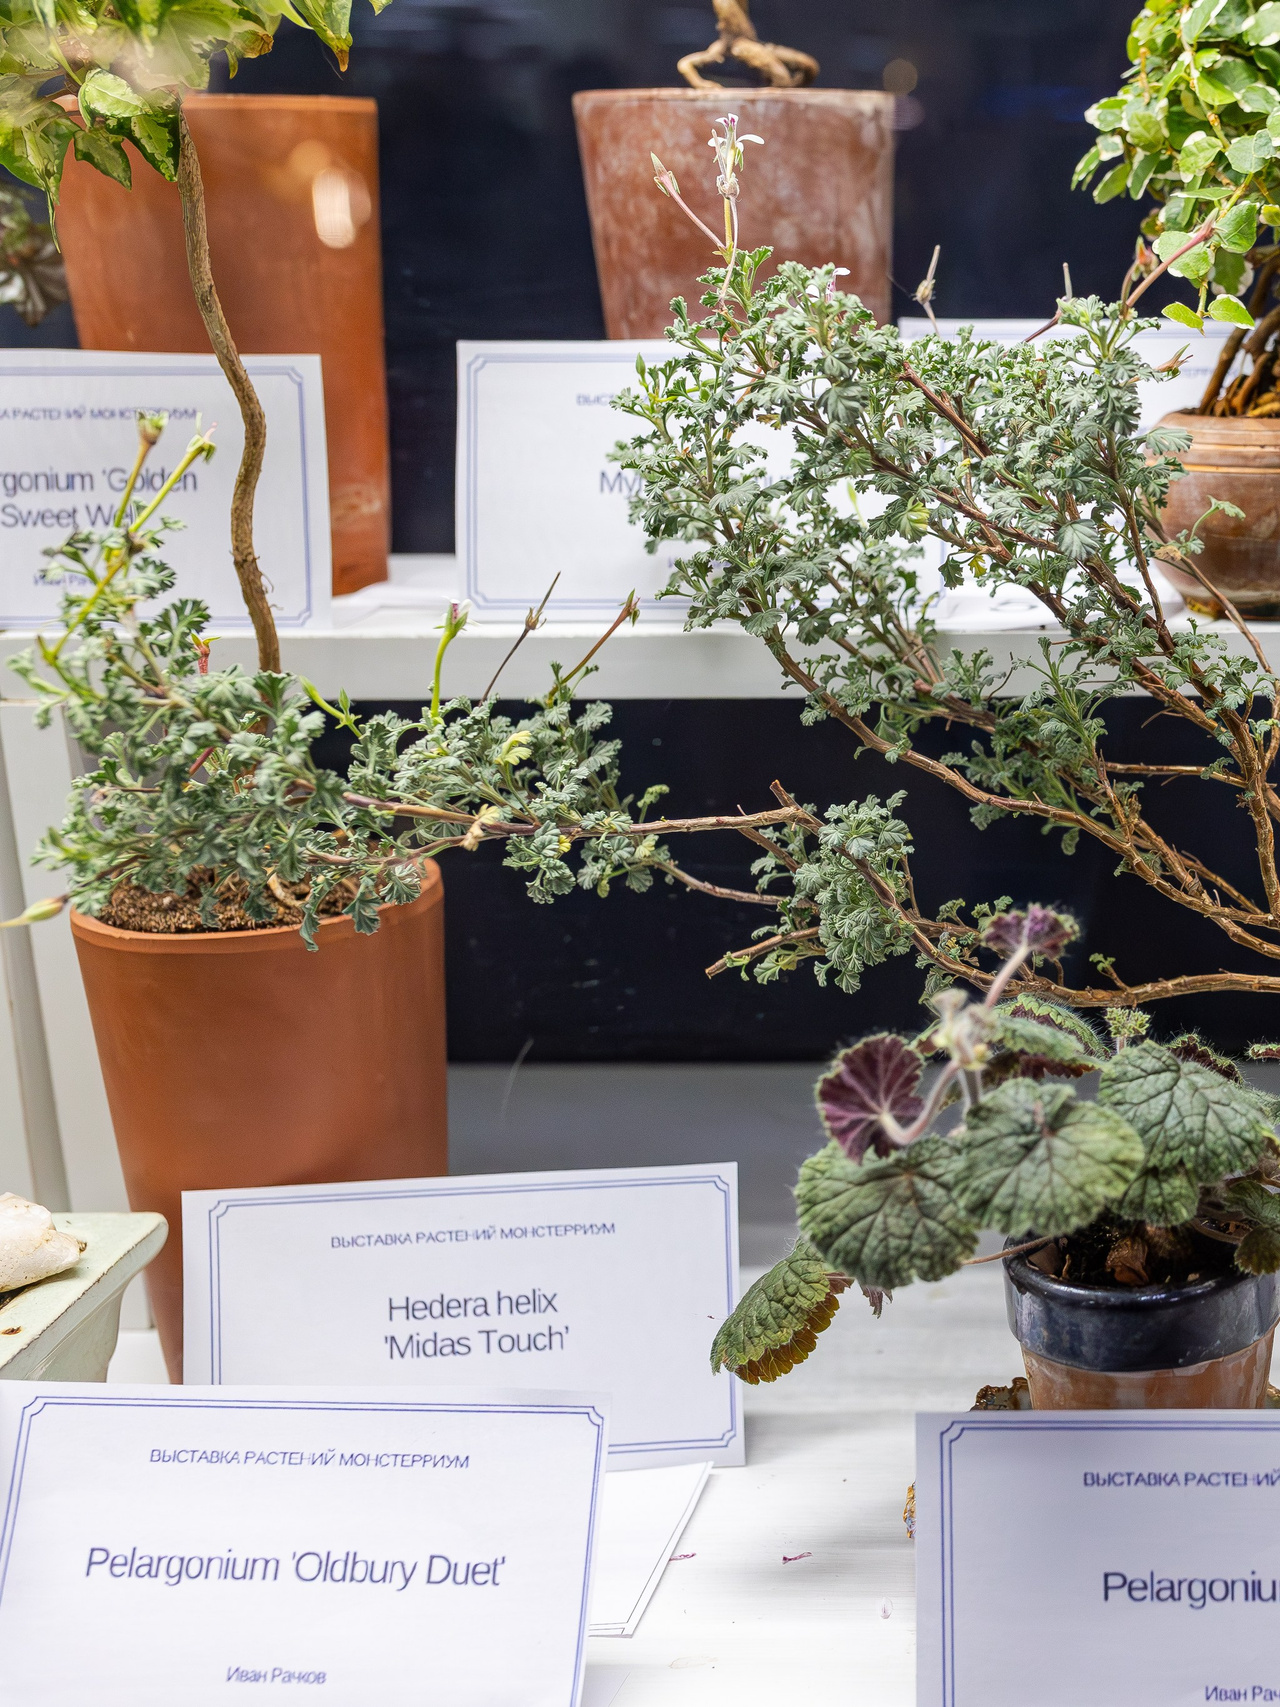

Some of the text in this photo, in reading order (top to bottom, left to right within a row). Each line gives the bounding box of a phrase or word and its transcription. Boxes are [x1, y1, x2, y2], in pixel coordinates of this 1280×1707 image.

[0, 465, 94, 498] gonium
[1, 503, 77, 528] Sweet
[331, 1222, 616, 1249] ВЫСТАВКА РАСТЕНИЙ МОНСТЕРРИУМ
[388, 1288, 559, 1322] Hedera helix
[384, 1331, 472, 1360] 'Midas
[149, 1448, 470, 1469] ВЫСТАВКА РАСТЕНИЙ МОНСТЕРРИУМ
[1084, 1471, 1181, 1488] ВЫСТАВКА
[85, 1546, 506, 1592] Pelargonium 'Oldbury Duet'
[226, 1666, 328, 1685] Иван Рачков
[1205, 1685, 1247, 1702] Иван
